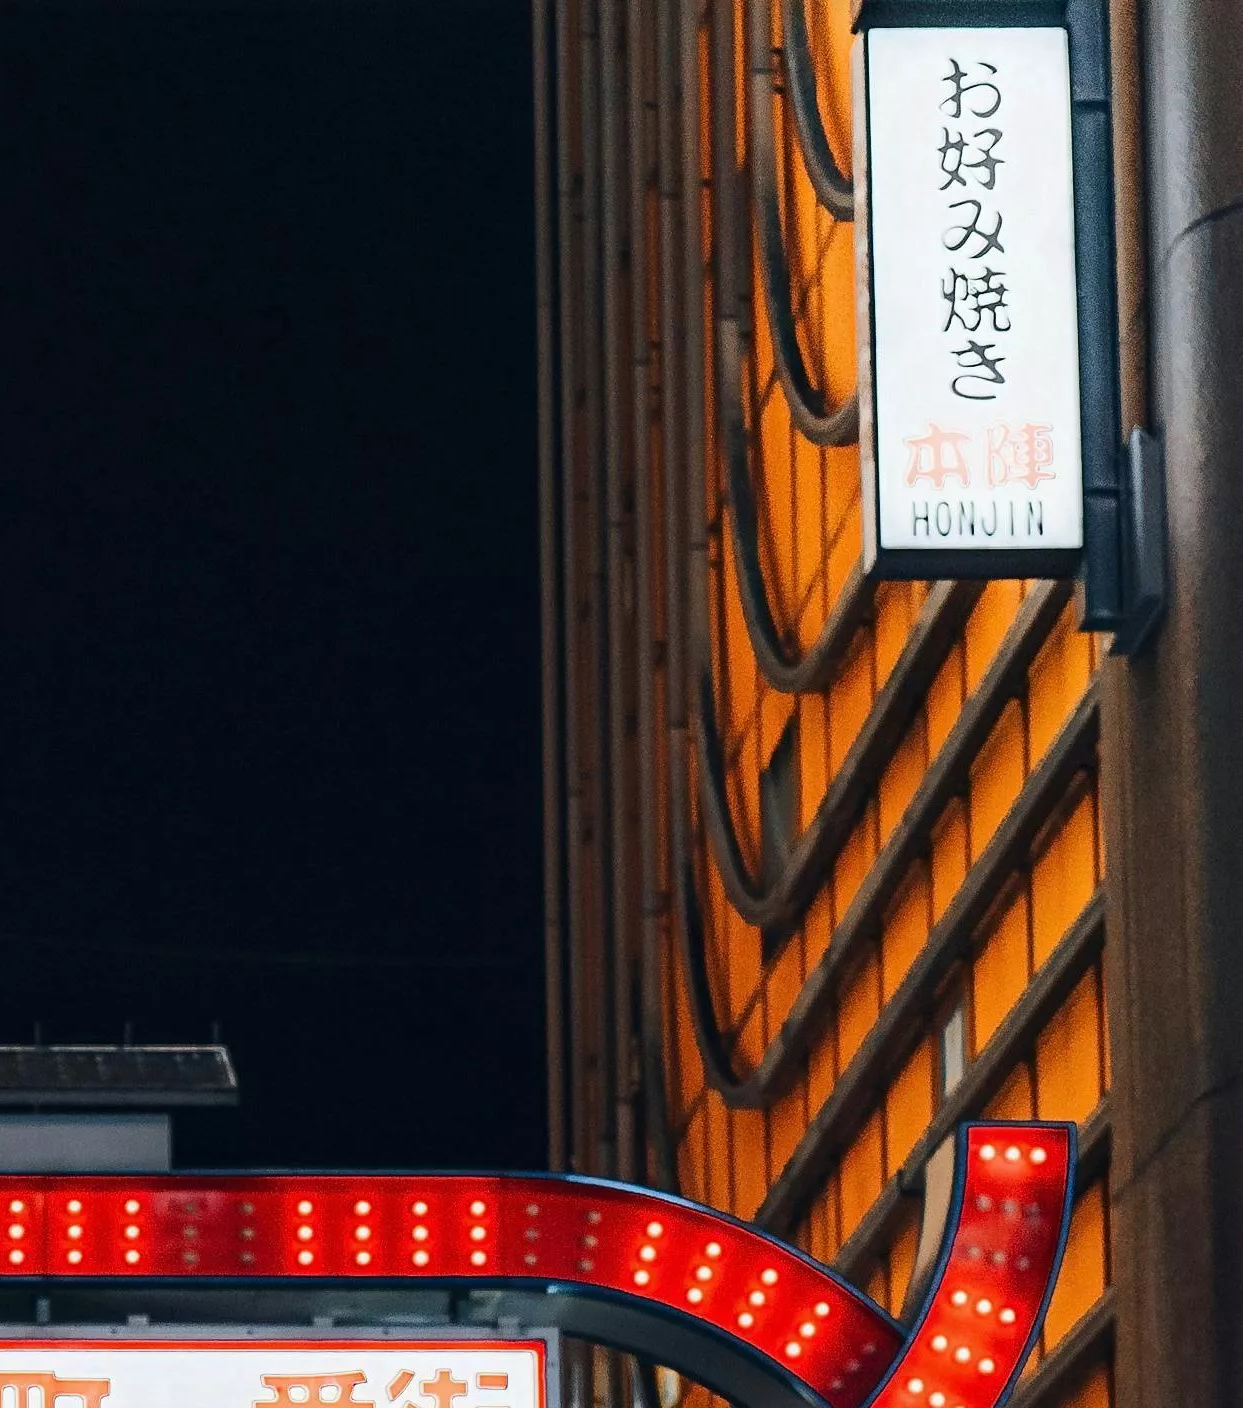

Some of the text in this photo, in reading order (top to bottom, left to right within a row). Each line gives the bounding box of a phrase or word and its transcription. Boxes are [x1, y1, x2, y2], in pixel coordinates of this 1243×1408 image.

[939, 57, 1012, 401] お好み焼き
[903, 419, 1057, 491] 本陣
[911, 499, 1045, 538] HONJIN
